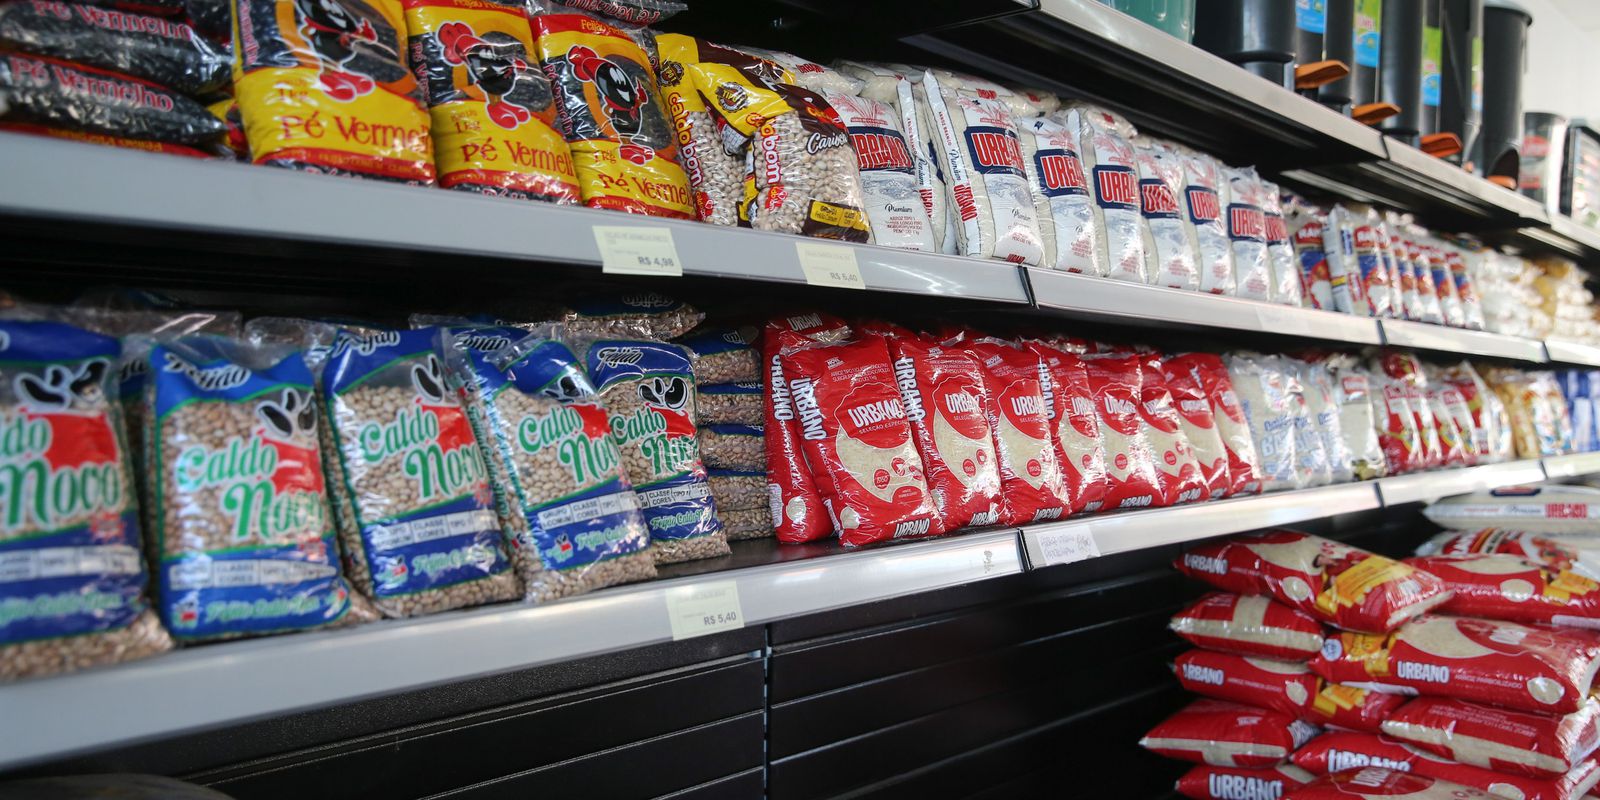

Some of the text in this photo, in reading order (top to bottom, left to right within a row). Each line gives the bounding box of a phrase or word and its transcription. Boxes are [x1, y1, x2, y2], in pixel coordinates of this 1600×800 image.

[76, 4, 193, 41] Vermelho
[52, 63, 175, 113] Vermelho
[282, 111, 325, 139] Pé
[461, 136, 498, 163] Pé
[668, 91, 704, 189] caldobom
[954, 183, 978, 223] URBANO
[653, 257, 675, 269] 4,98
[596, 347, 644, 369] Feijão
[789, 377, 828, 441] URBANO
[847, 397, 907, 428] URBANO
[360, 405, 441, 464] Caldo
[517, 405, 584, 456] Caldo
[610, 402, 668, 446] Caldo
[174, 433, 279, 494] Caldo
[402, 444, 488, 502] Novo
[573, 500, 598, 511] CLASSE
[648, 490, 670, 499] CLASSE
[652, 497, 673, 505] CORES
[221, 479, 325, 541] Novo
[893, 518, 931, 538] URBANO
[703, 611, 737, 626] R$ 5,40
[1182, 663, 1225, 686] URBANO
[1396, 660, 1450, 684] URBANO
[1208, 773, 1283, 800] URBANO
